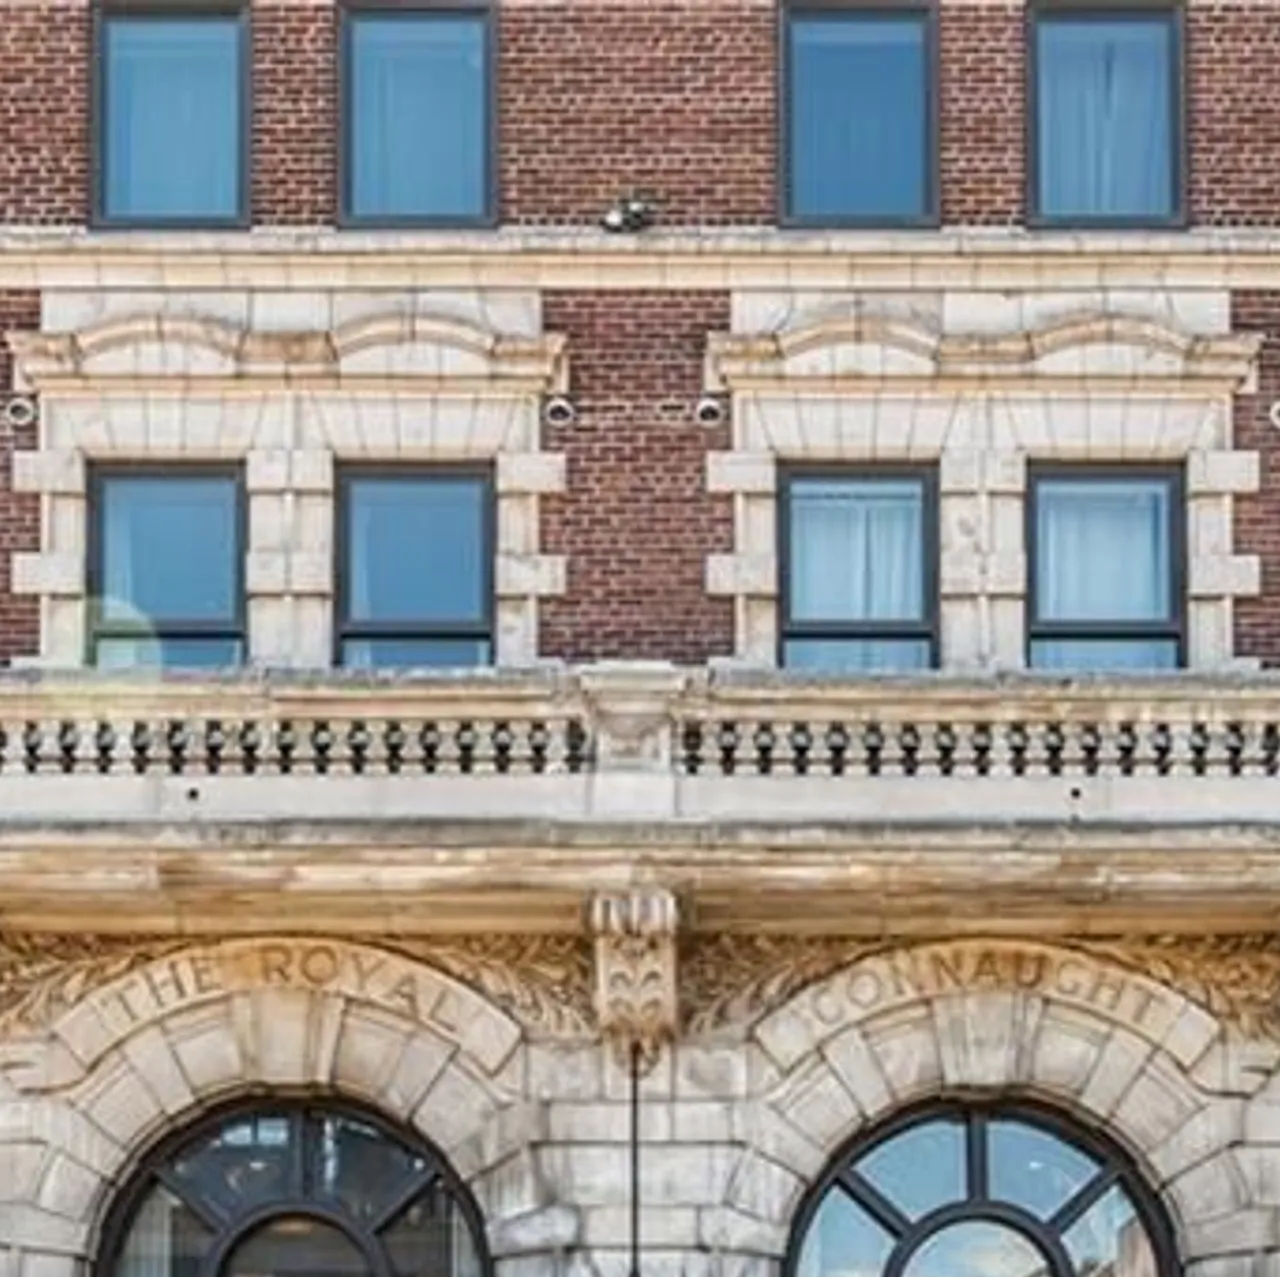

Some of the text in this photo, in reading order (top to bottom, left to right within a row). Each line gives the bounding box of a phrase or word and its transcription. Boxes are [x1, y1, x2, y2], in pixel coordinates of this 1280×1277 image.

[103, 944, 459, 1032] THE ROYAL
[812, 949, 1166, 1026] CONNAUGHT
